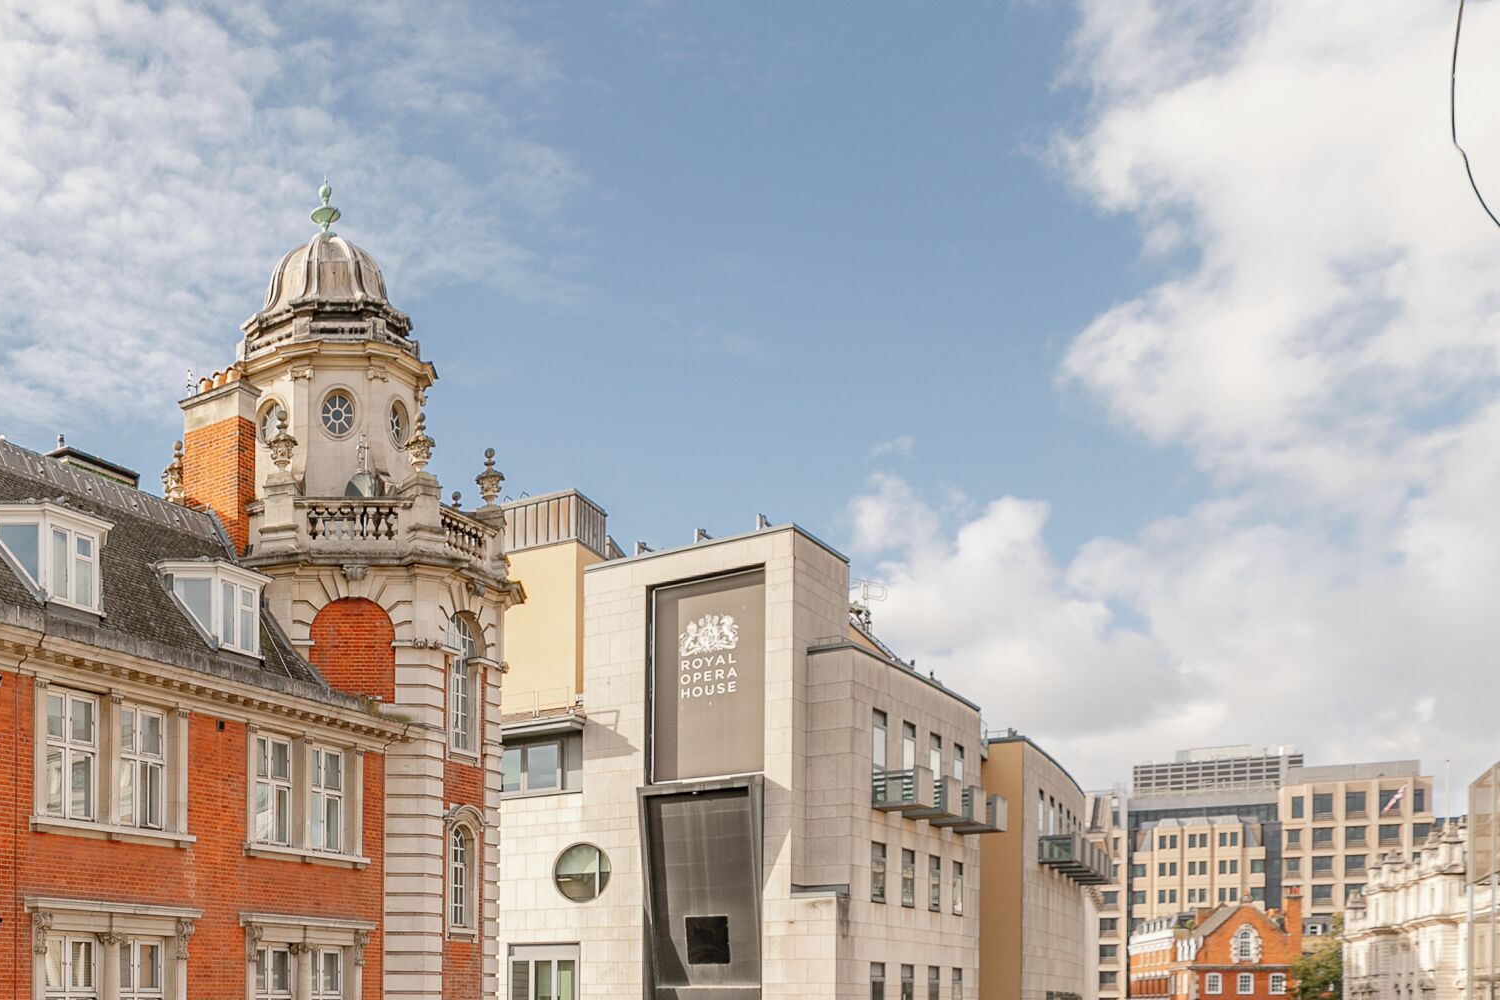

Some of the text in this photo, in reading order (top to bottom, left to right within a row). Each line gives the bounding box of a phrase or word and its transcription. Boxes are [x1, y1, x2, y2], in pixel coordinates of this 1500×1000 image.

[681, 653, 736, 671] ROYAL
[681, 667, 738, 685] OPERA
[681, 681, 737, 699] HOUSE
